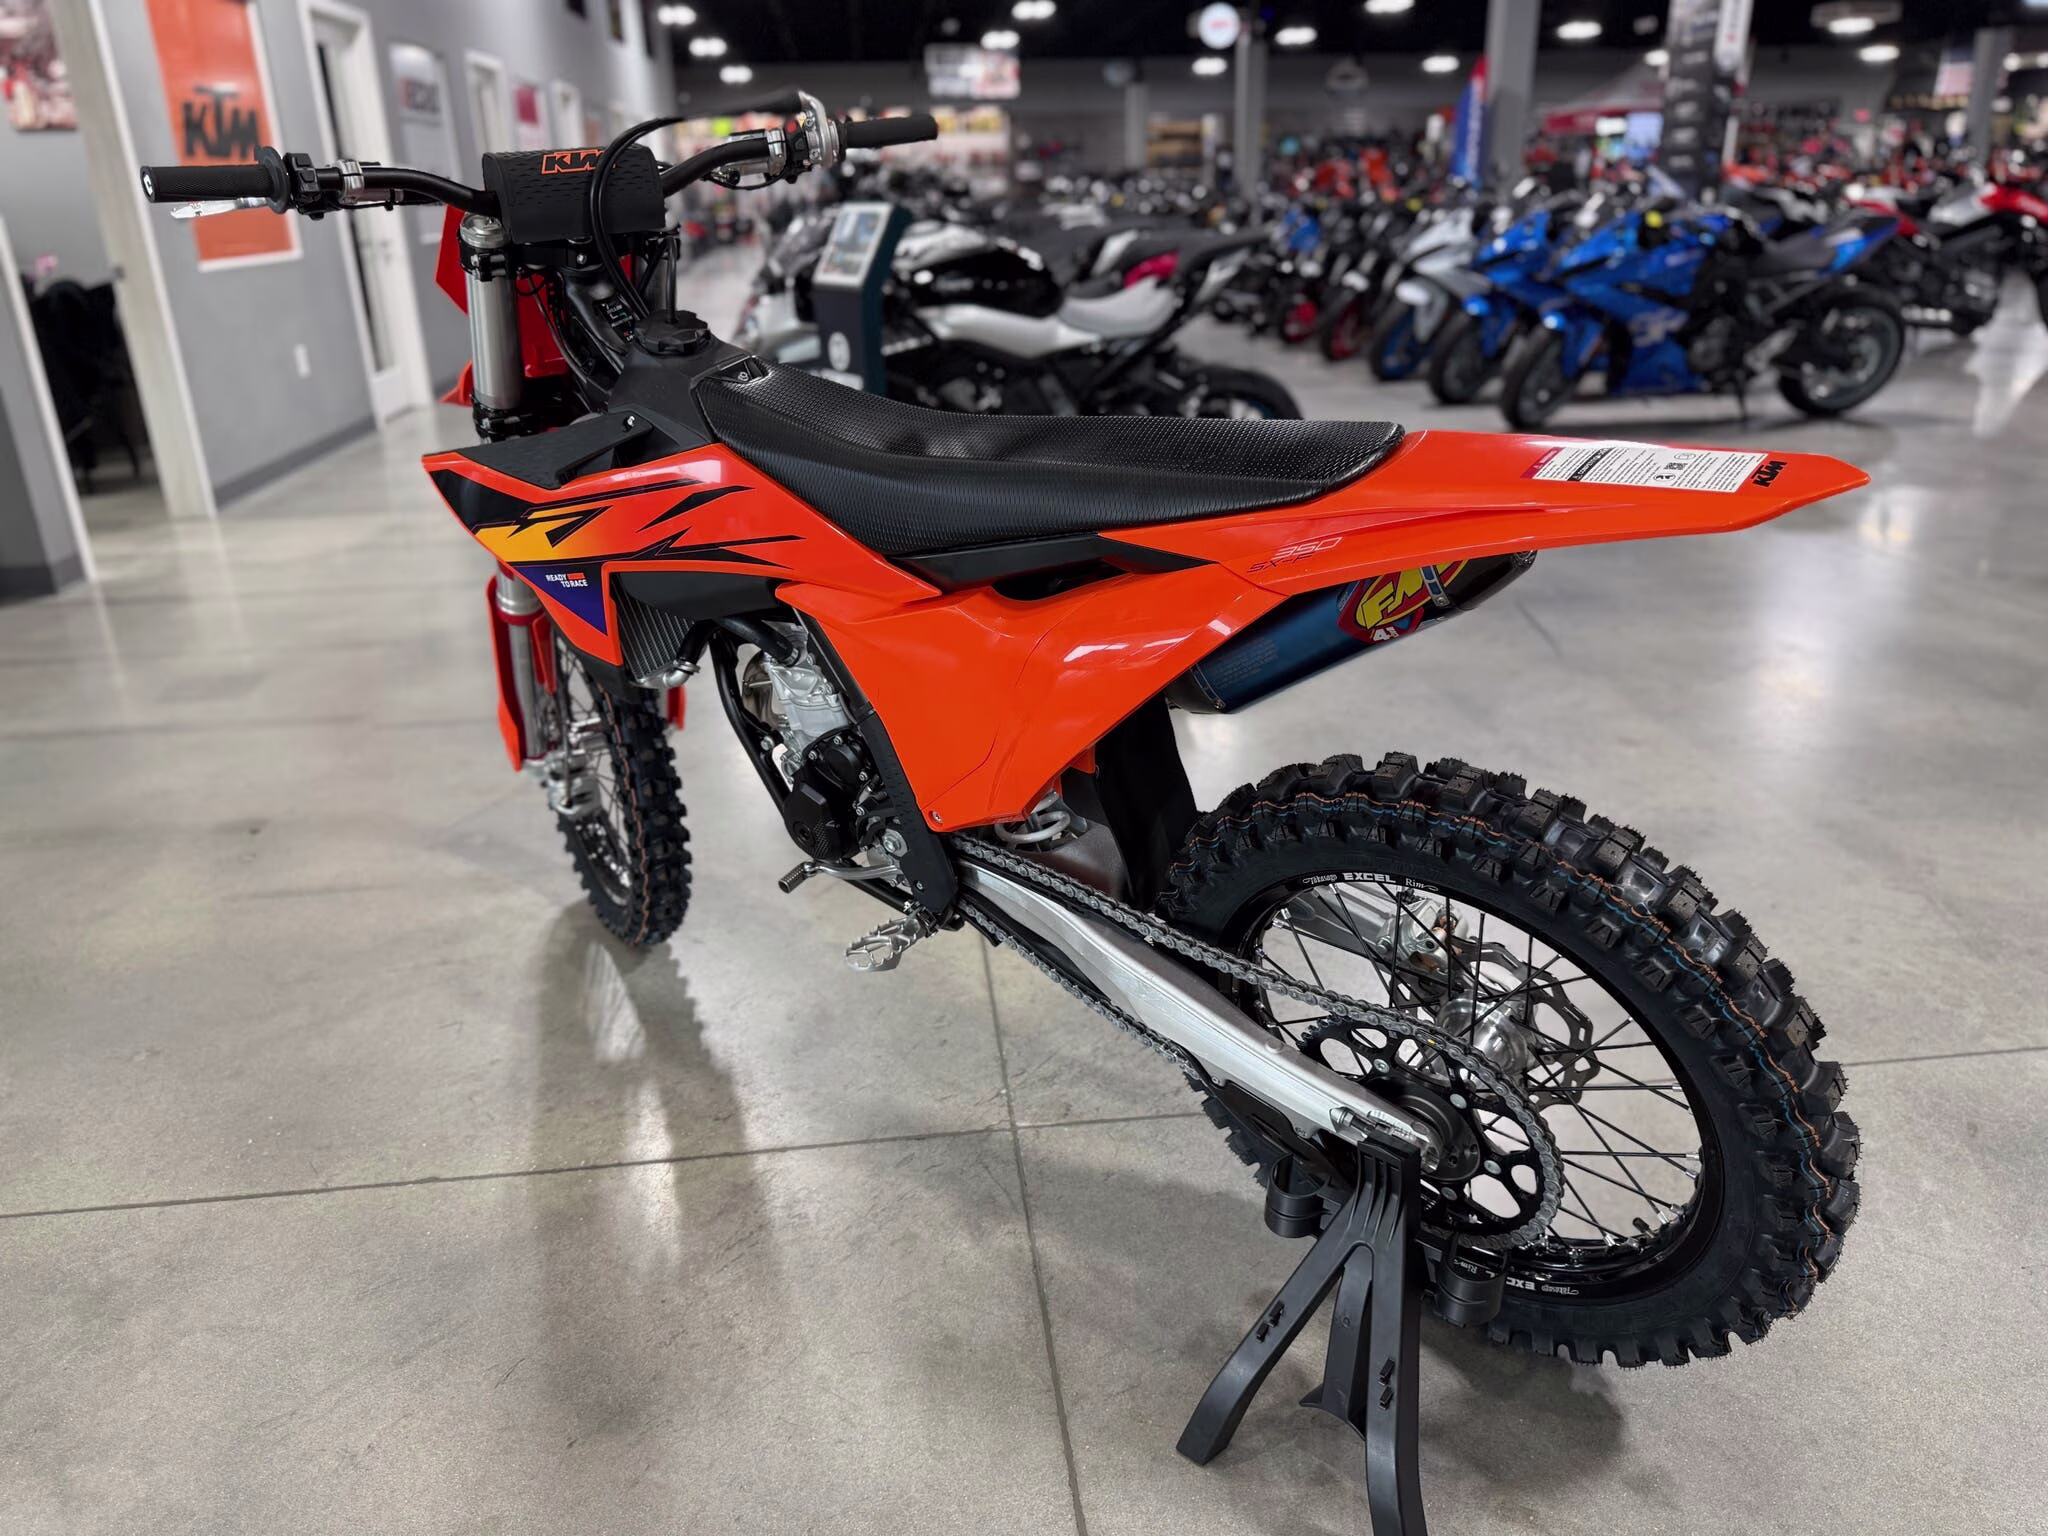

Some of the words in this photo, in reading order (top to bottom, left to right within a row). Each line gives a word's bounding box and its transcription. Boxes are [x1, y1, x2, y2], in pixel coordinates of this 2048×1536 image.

[183, 85, 258, 158] KTM
[1751, 460, 1787, 487] KTM
[1270, 536, 1342, 560] 350
[1247, 551, 1314, 574] SX-F
[545, 573, 567, 581] READY
[561, 580, 570, 588] TO
[570, 579, 588, 587] RACE
[1342, 872, 1396, 883] EXCEL
